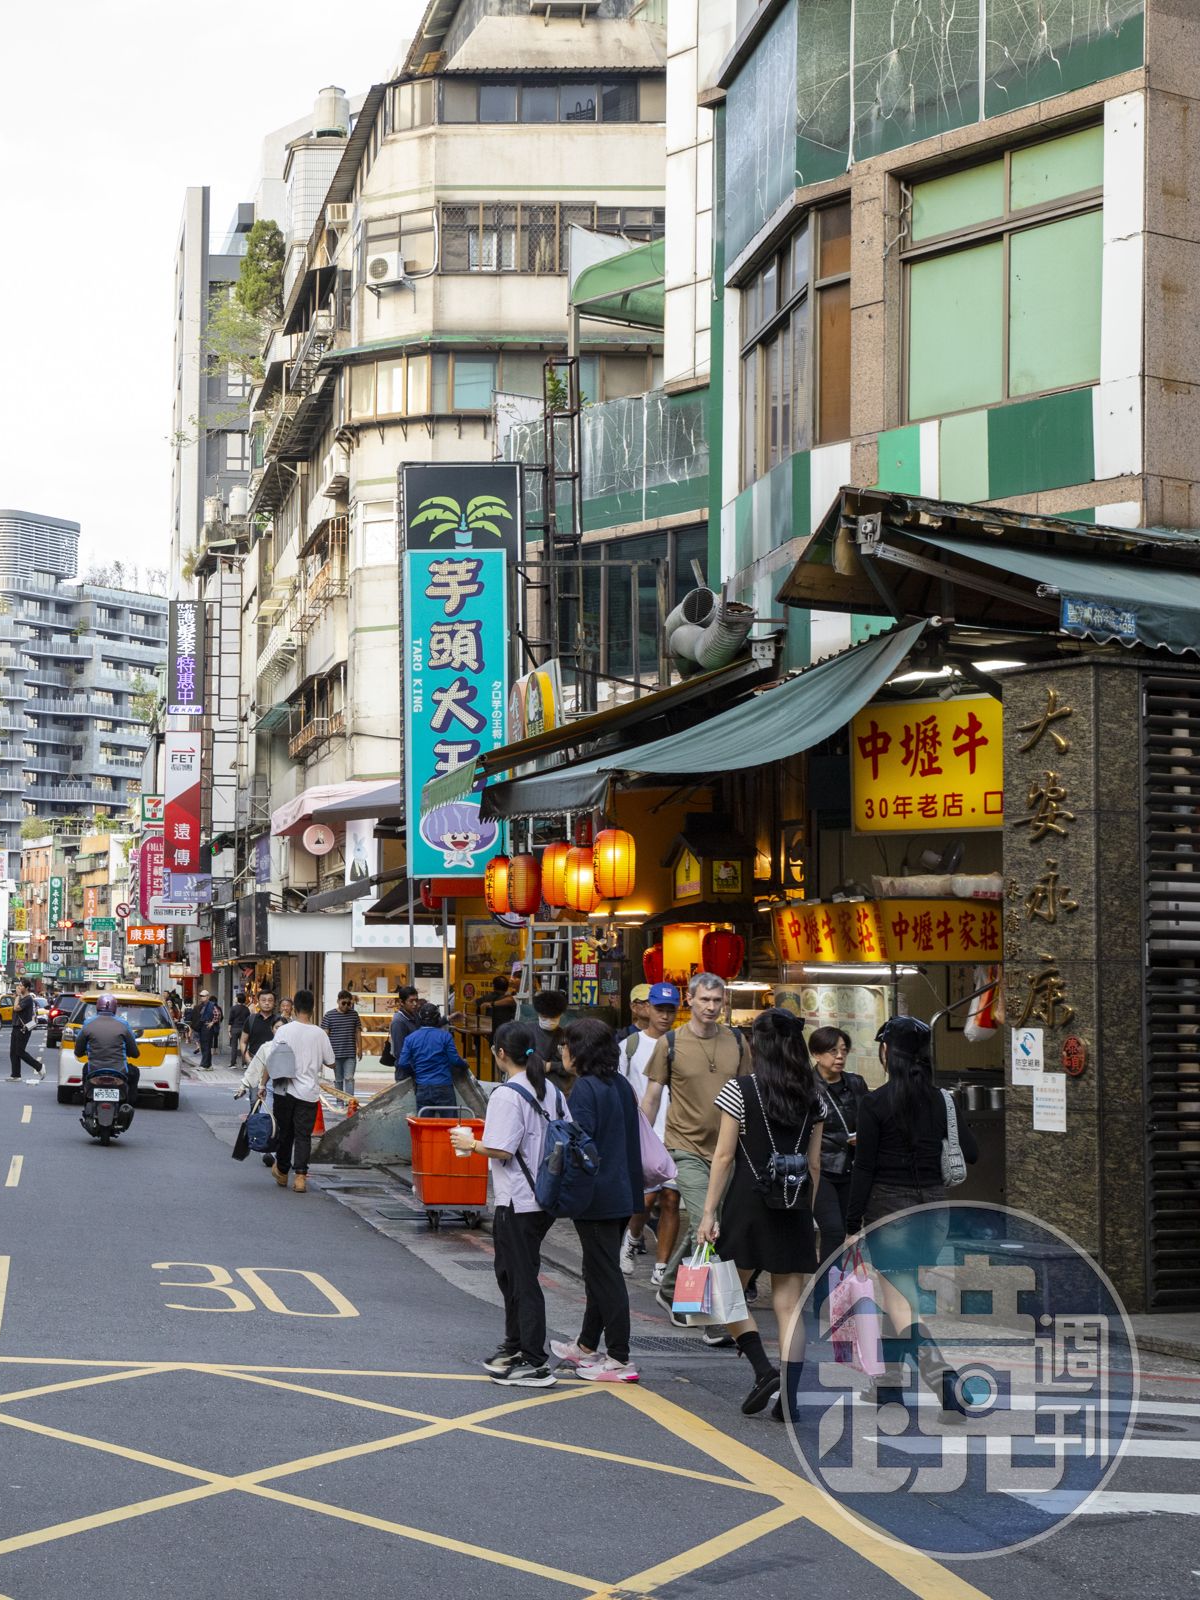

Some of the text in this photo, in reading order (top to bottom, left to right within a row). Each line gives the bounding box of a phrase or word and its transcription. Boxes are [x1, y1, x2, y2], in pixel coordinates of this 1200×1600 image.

[412, 637, 423, 714] TARO KING
[424, 558, 486, 793] 芋頭大王
[171, 754, 196, 763] FET
[856, 712, 990, 781] 中壢牛
[173, 823, 191, 867] 遠傳
[1013, 687, 1079, 1029] 大安永康
[174, 909, 194, 917] FET
[891, 909, 1000, 952] 中壢牛家莊
[150, 1261, 361, 1318] 30
